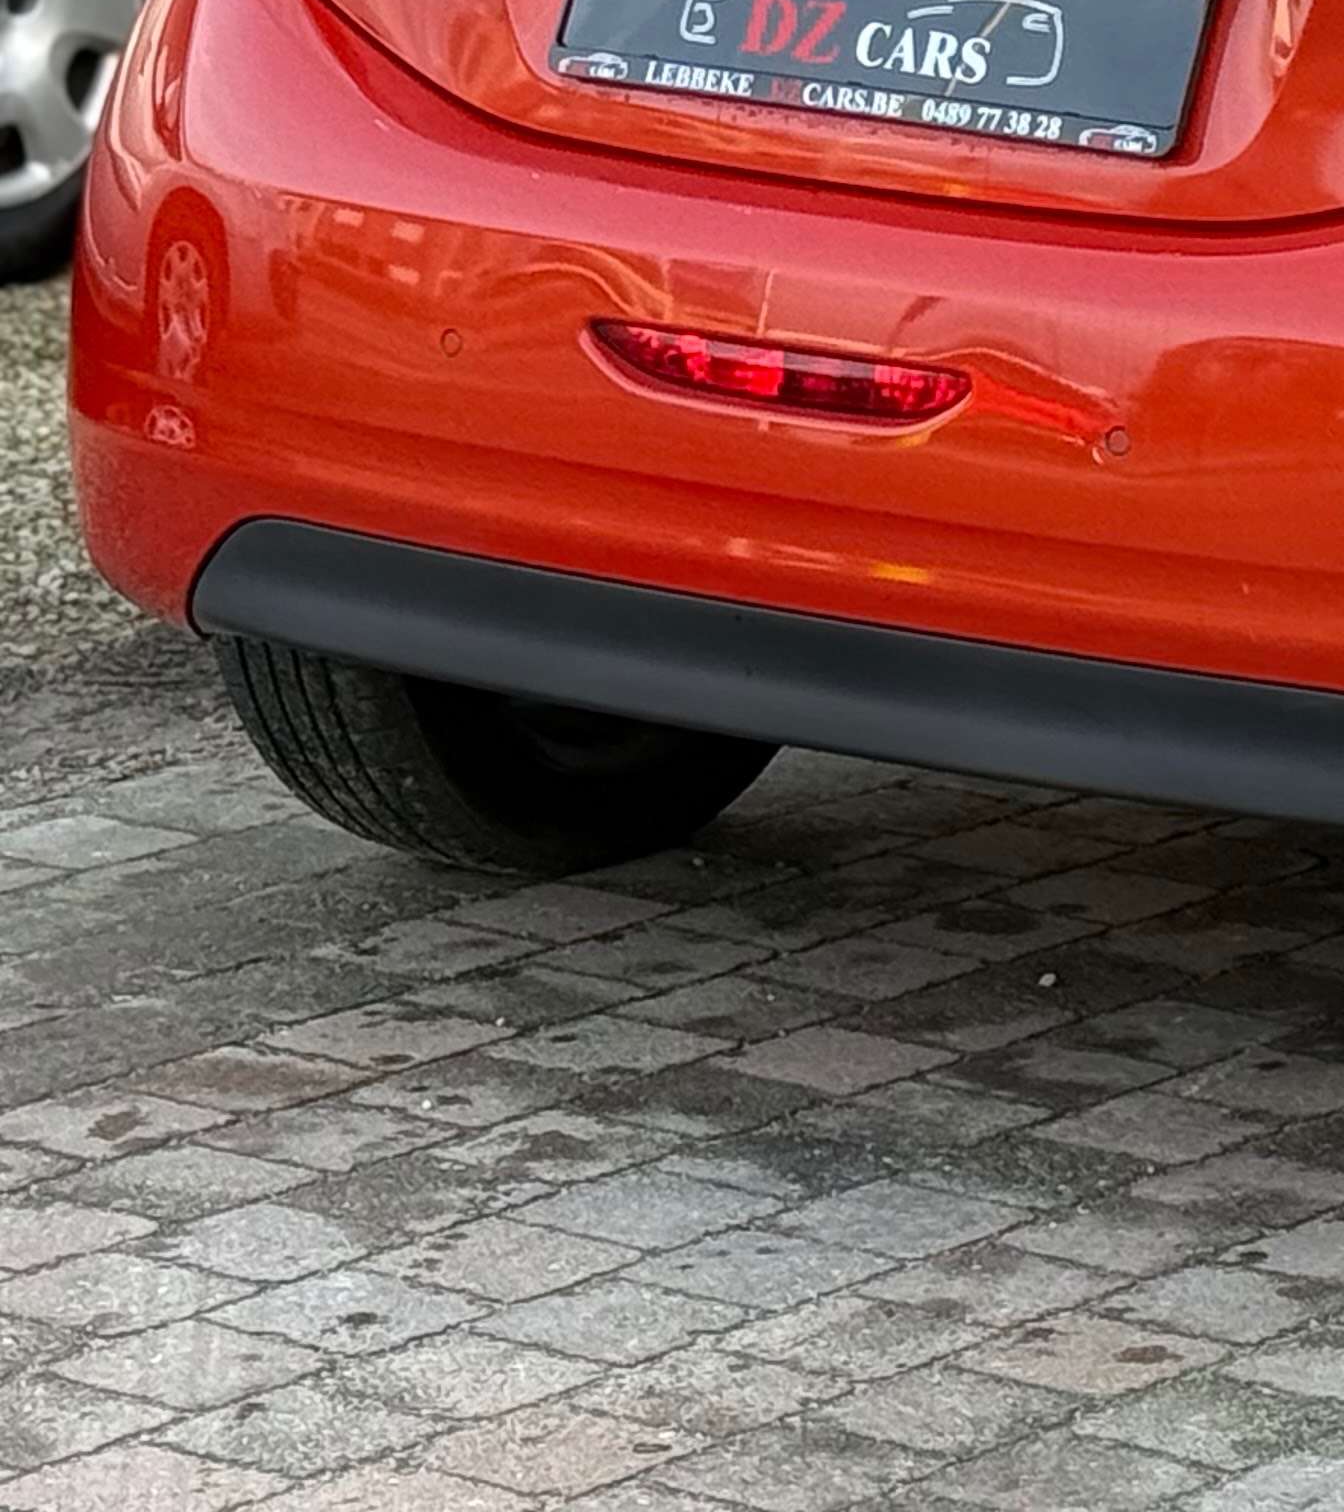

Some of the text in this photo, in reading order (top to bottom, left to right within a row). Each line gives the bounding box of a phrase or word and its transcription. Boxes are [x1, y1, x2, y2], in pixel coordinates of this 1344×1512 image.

[855, 21, 992, 86] CARS
[645, 60, 754, 97] LEBBEKE
[922, 100, 970, 126] 0489
[976, 107, 1003, 132] 77
[1003, 111, 1030, 135] 38
[1033, 114, 1062, 141] 28
